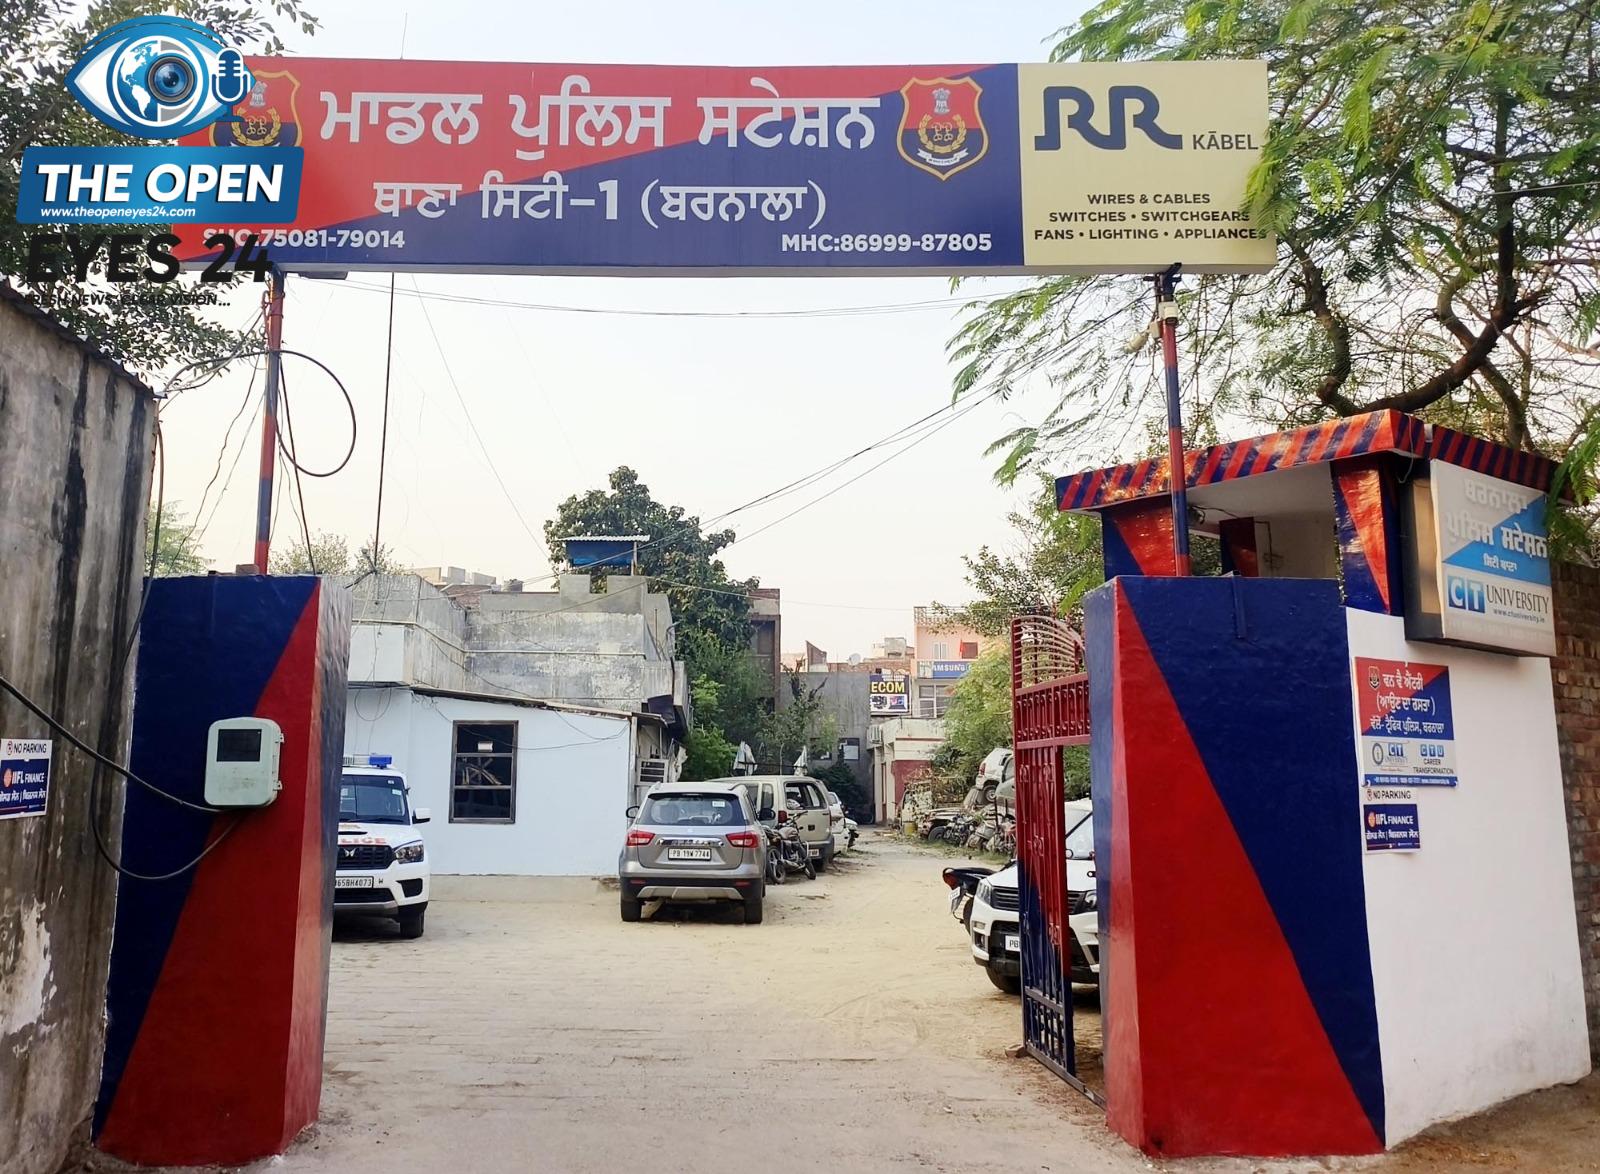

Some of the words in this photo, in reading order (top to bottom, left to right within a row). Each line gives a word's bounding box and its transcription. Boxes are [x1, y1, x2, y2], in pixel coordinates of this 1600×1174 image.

[319, 91, 483, 145] ਮਾਡਲ
[509, 75, 672, 161] ਪੁਲਿਸ
[697, 77, 881, 148] ਸਟੇਸ਼ਨ
[1034, 85, 1183, 151] RR
[373, 182, 463, 218] ਥਾਣਾ
[641, 179, 827, 230] (ਬਰਨਾਲਾ)
[1087, 193, 1136, 205] WIRES
[1139, 194, 1149, 204] &
[1152, 193, 1211, 204] CABLES
[1049, 211, 1127, 222] SWITCHES
[1141, 210, 1250, 222] SWITCHGEARS
[1034, 229, 1075, 241] FANS
[1089, 228, 1159, 240] LIGHTING
[1173, 228, 1268, 240] APPLIANCES
[781, 233, 993, 253] MHC:86999-87805
[1449, 576, 1484, 612] CT
[1486, 585, 1549, 613] UNIVERSITY
[871, 682, 904, 692] ECOM
[14, 744, 22, 753] NO
[23, 743, 47, 754] PARKING
[1413, 766, 1454, 775] TRANSFORMATION
[25, 772, 45, 783] FINANCE
[1373, 790, 1381, 800] NO
[1382, 790, 1411, 800] PARKING
[1388, 815, 1414, 825] FINANCE
